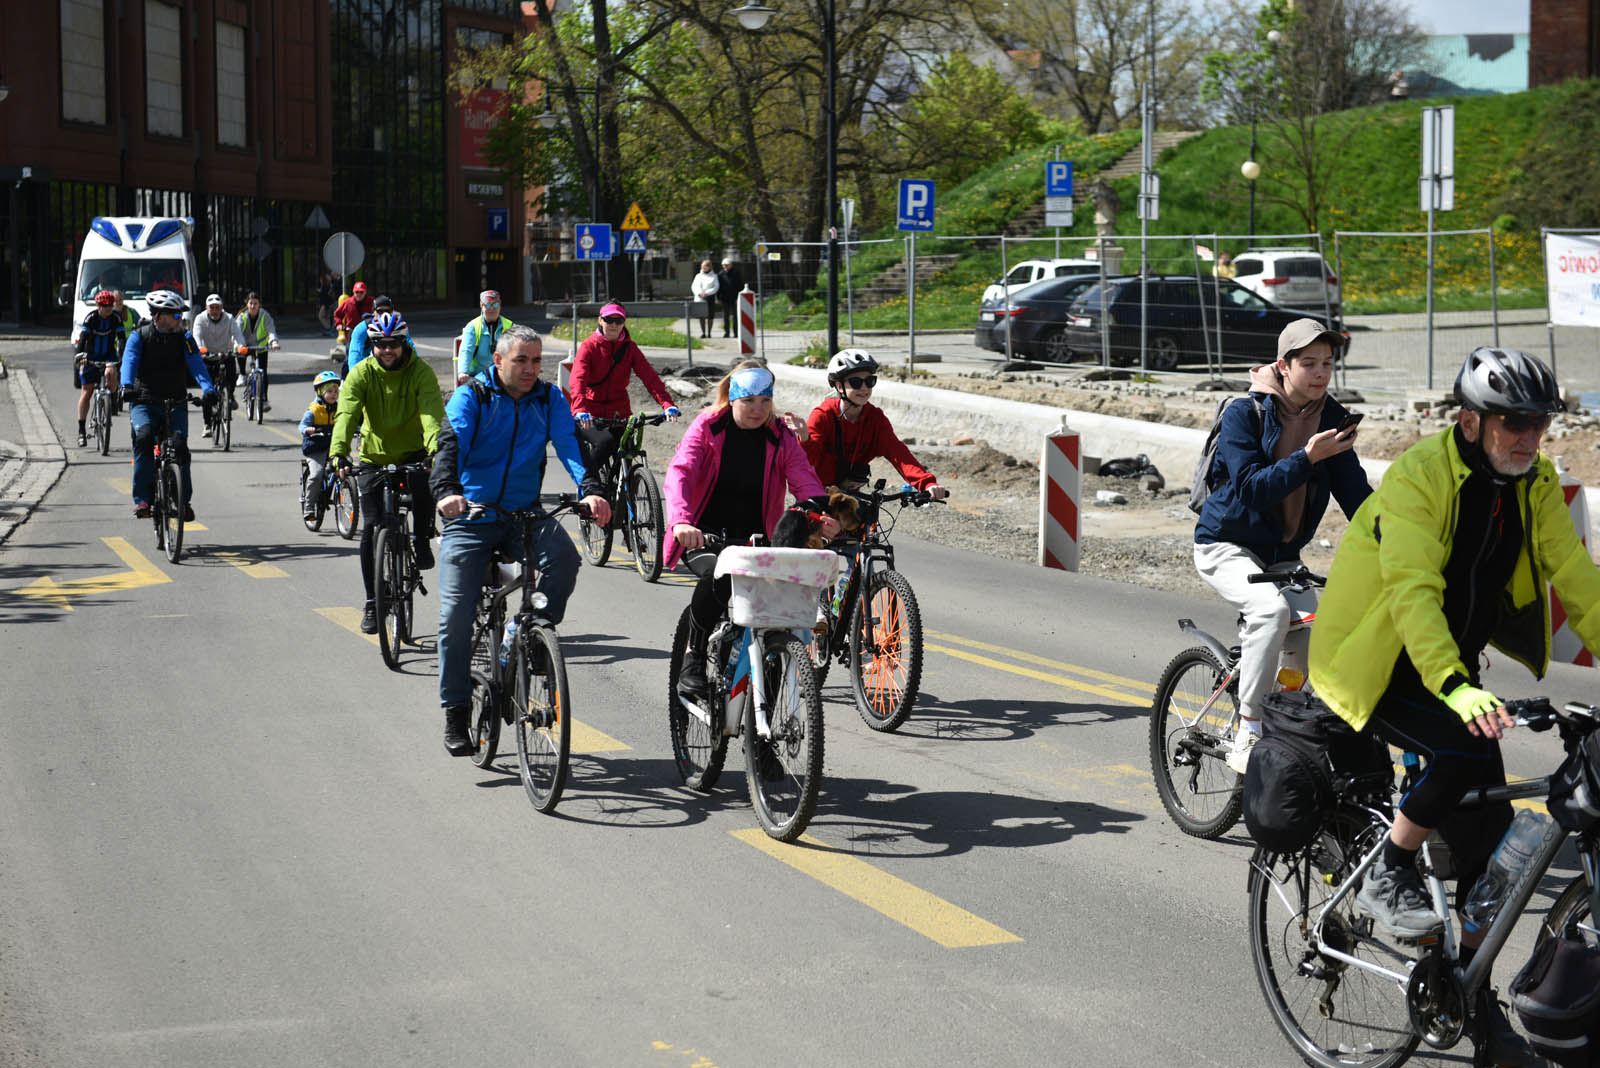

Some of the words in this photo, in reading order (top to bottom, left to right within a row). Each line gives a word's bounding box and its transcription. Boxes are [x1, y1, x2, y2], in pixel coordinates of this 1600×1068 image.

[1052, 164, 1067, 186] P
[907, 184, 928, 216] P
[494, 215, 503, 231] P
